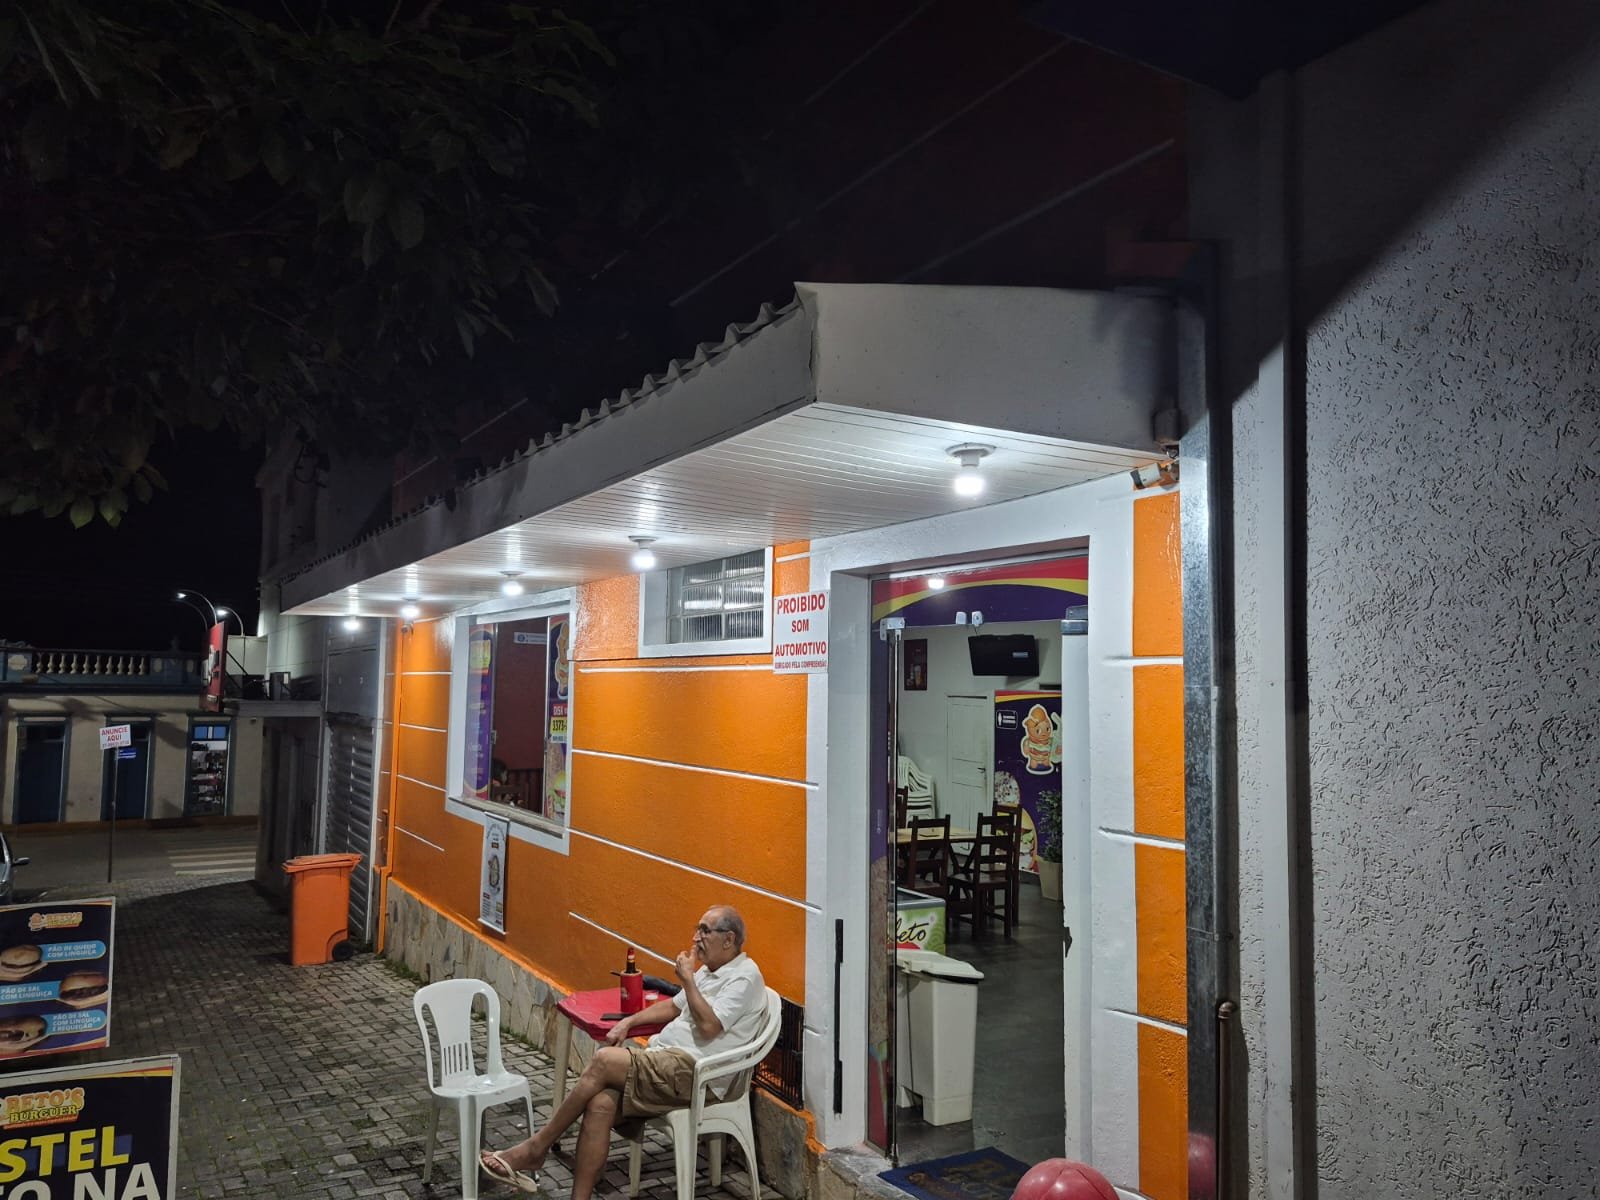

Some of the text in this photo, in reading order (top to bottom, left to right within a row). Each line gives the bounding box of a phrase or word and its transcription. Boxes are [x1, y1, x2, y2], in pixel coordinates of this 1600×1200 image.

[777, 593, 826, 615] PROIBIDO
[791, 619, 809, 633] SOM
[775, 641, 827, 657] AUTOMOTIVO
[101, 726, 128, 736] ANUNCIE
[107, 734, 122, 742] AQUI
[6, 1087, 85, 1113] BETO'S
[9, 1105, 78, 1124] BURGUER
